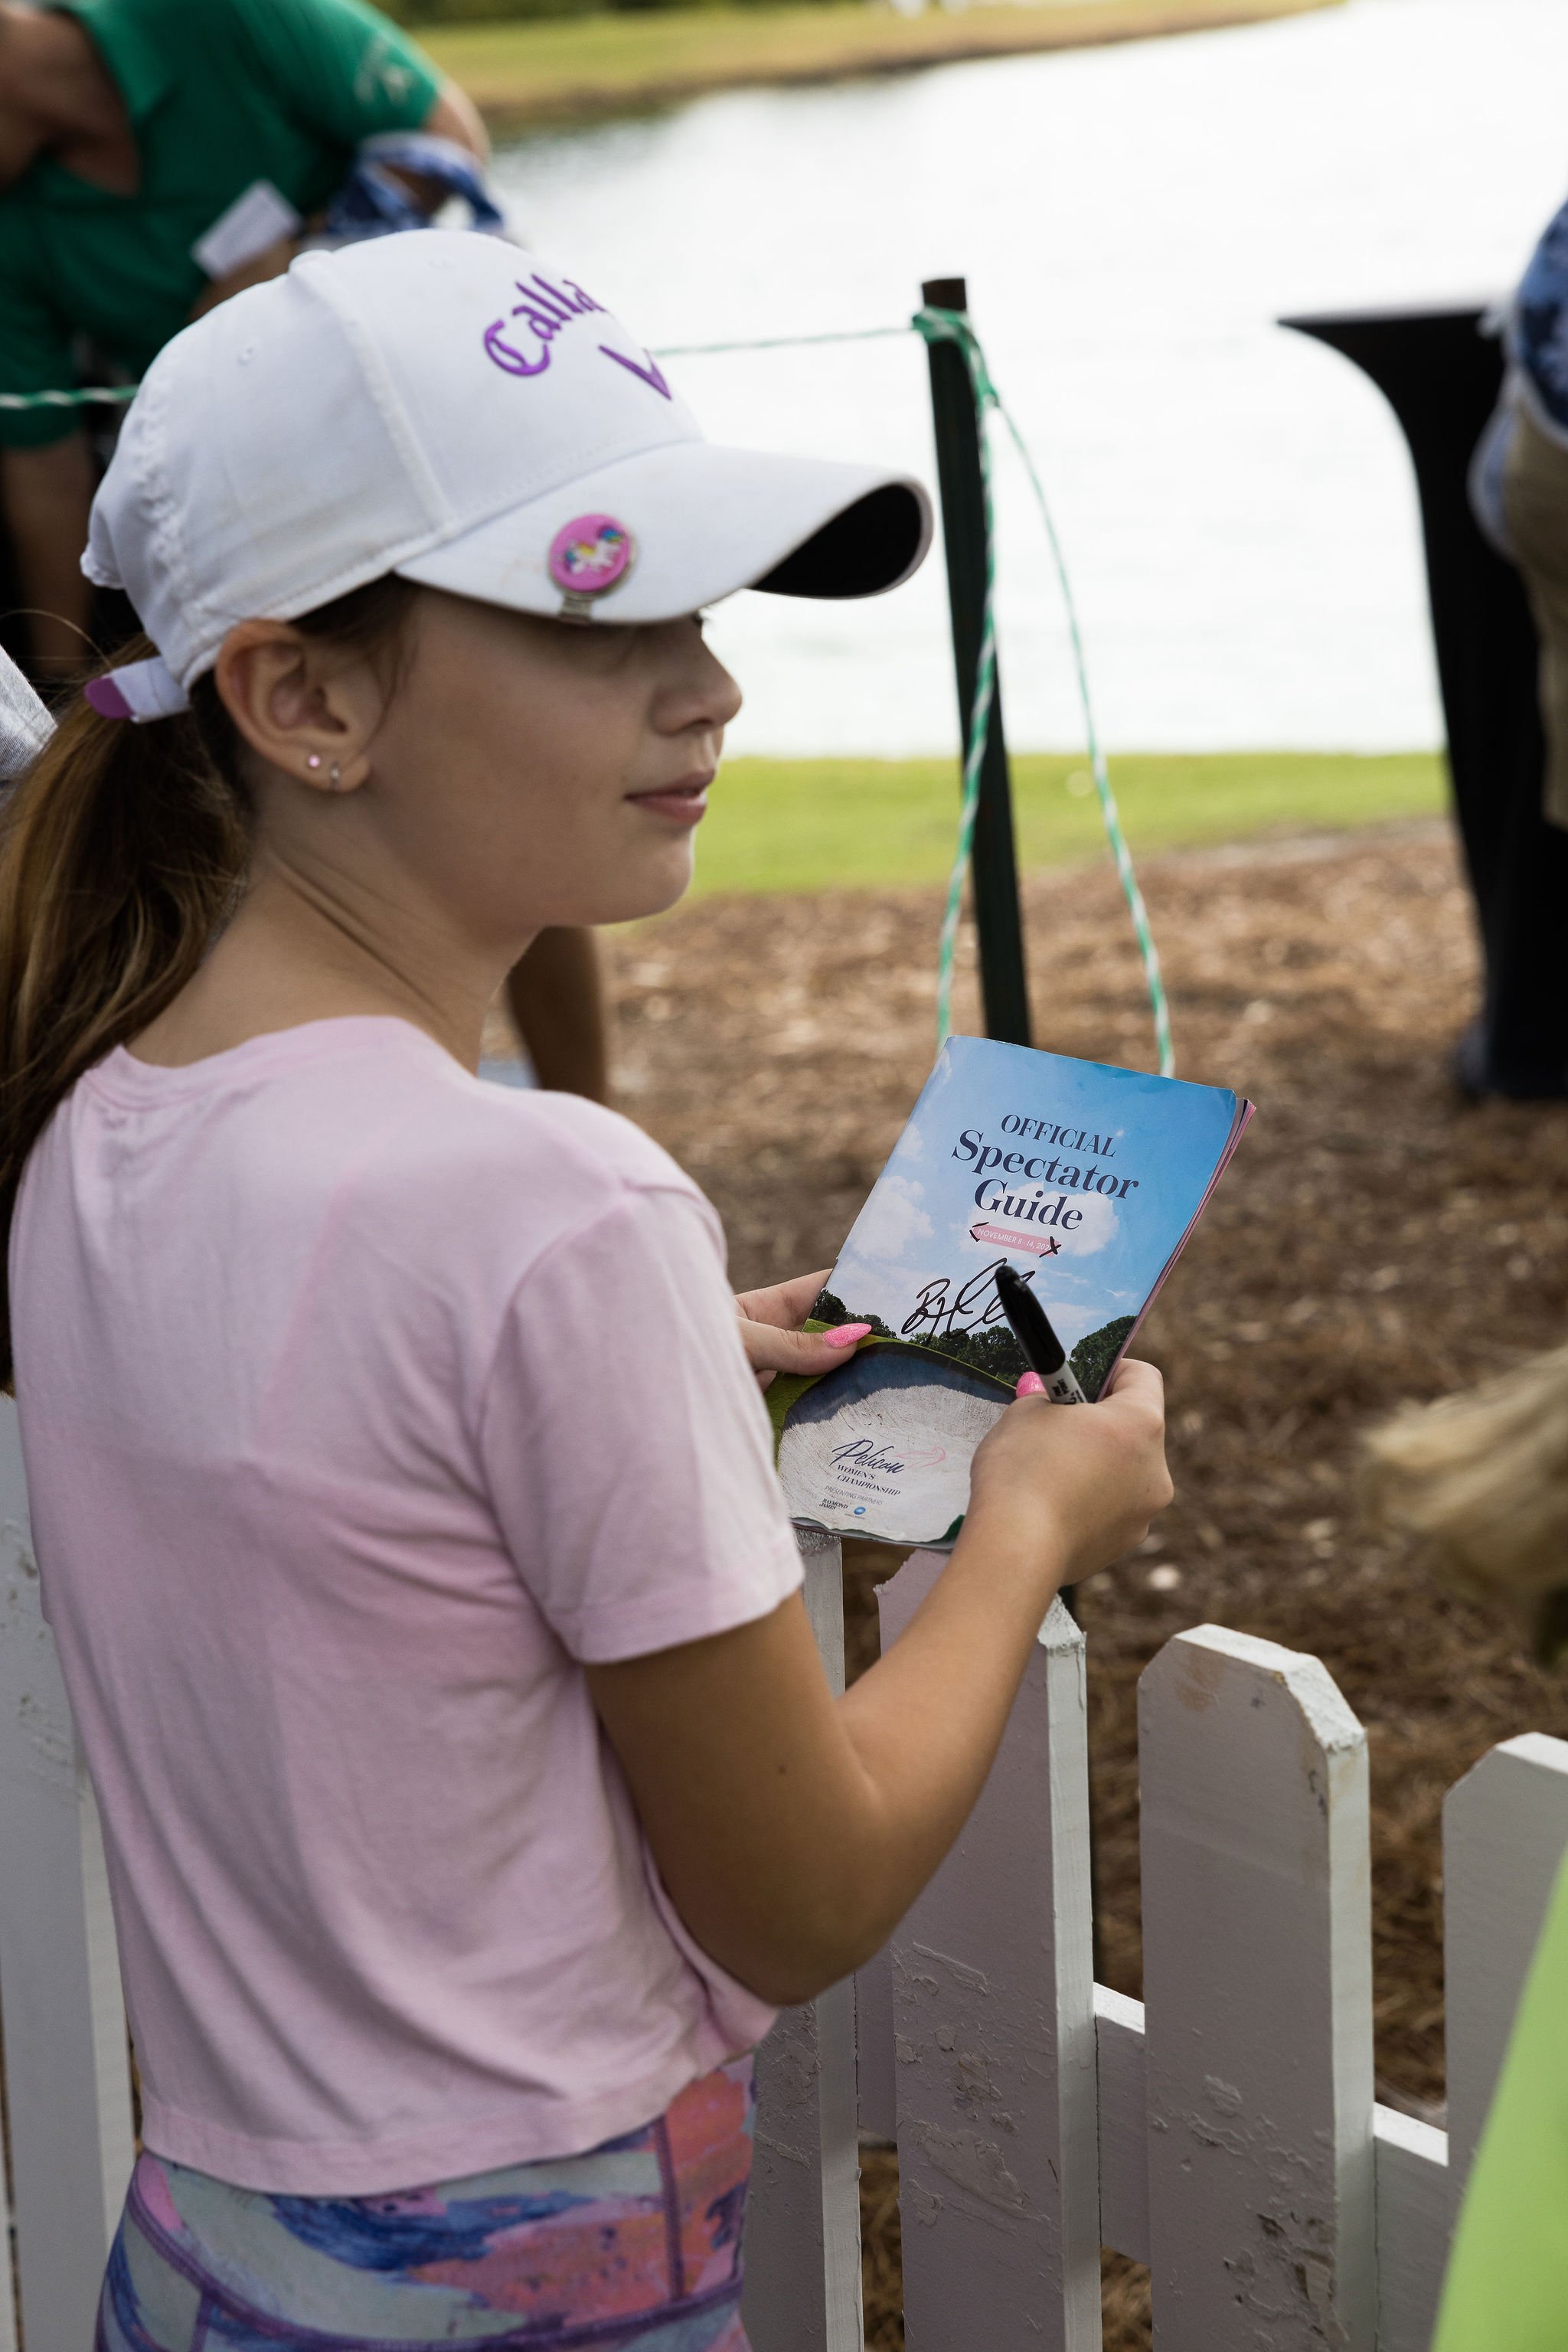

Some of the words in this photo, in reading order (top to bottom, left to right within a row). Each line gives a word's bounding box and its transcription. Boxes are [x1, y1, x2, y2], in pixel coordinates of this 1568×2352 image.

[484, 273, 607, 376] Calla
[1001, 1114, 1116, 1158] OFFICIAL
[951, 1129, 1139, 1200] Spectator
[974, 1179, 1083, 1230] Guide
[977, 1228, 1017, 1243] NOVEMBER
[828, 1439, 905, 1475] Pelican
[837, 1464, 877, 1480] WOMEN'S
[824, 1485, 858, 1499] PRESENTING
[857, 1495, 884, 1506] PARTNERS
[837, 1475, 901, 1496] CHAMPIONSHIP
[819, 1502, 837, 1511] JAMES
[822, 1498, 848, 1509] RAYMOND
